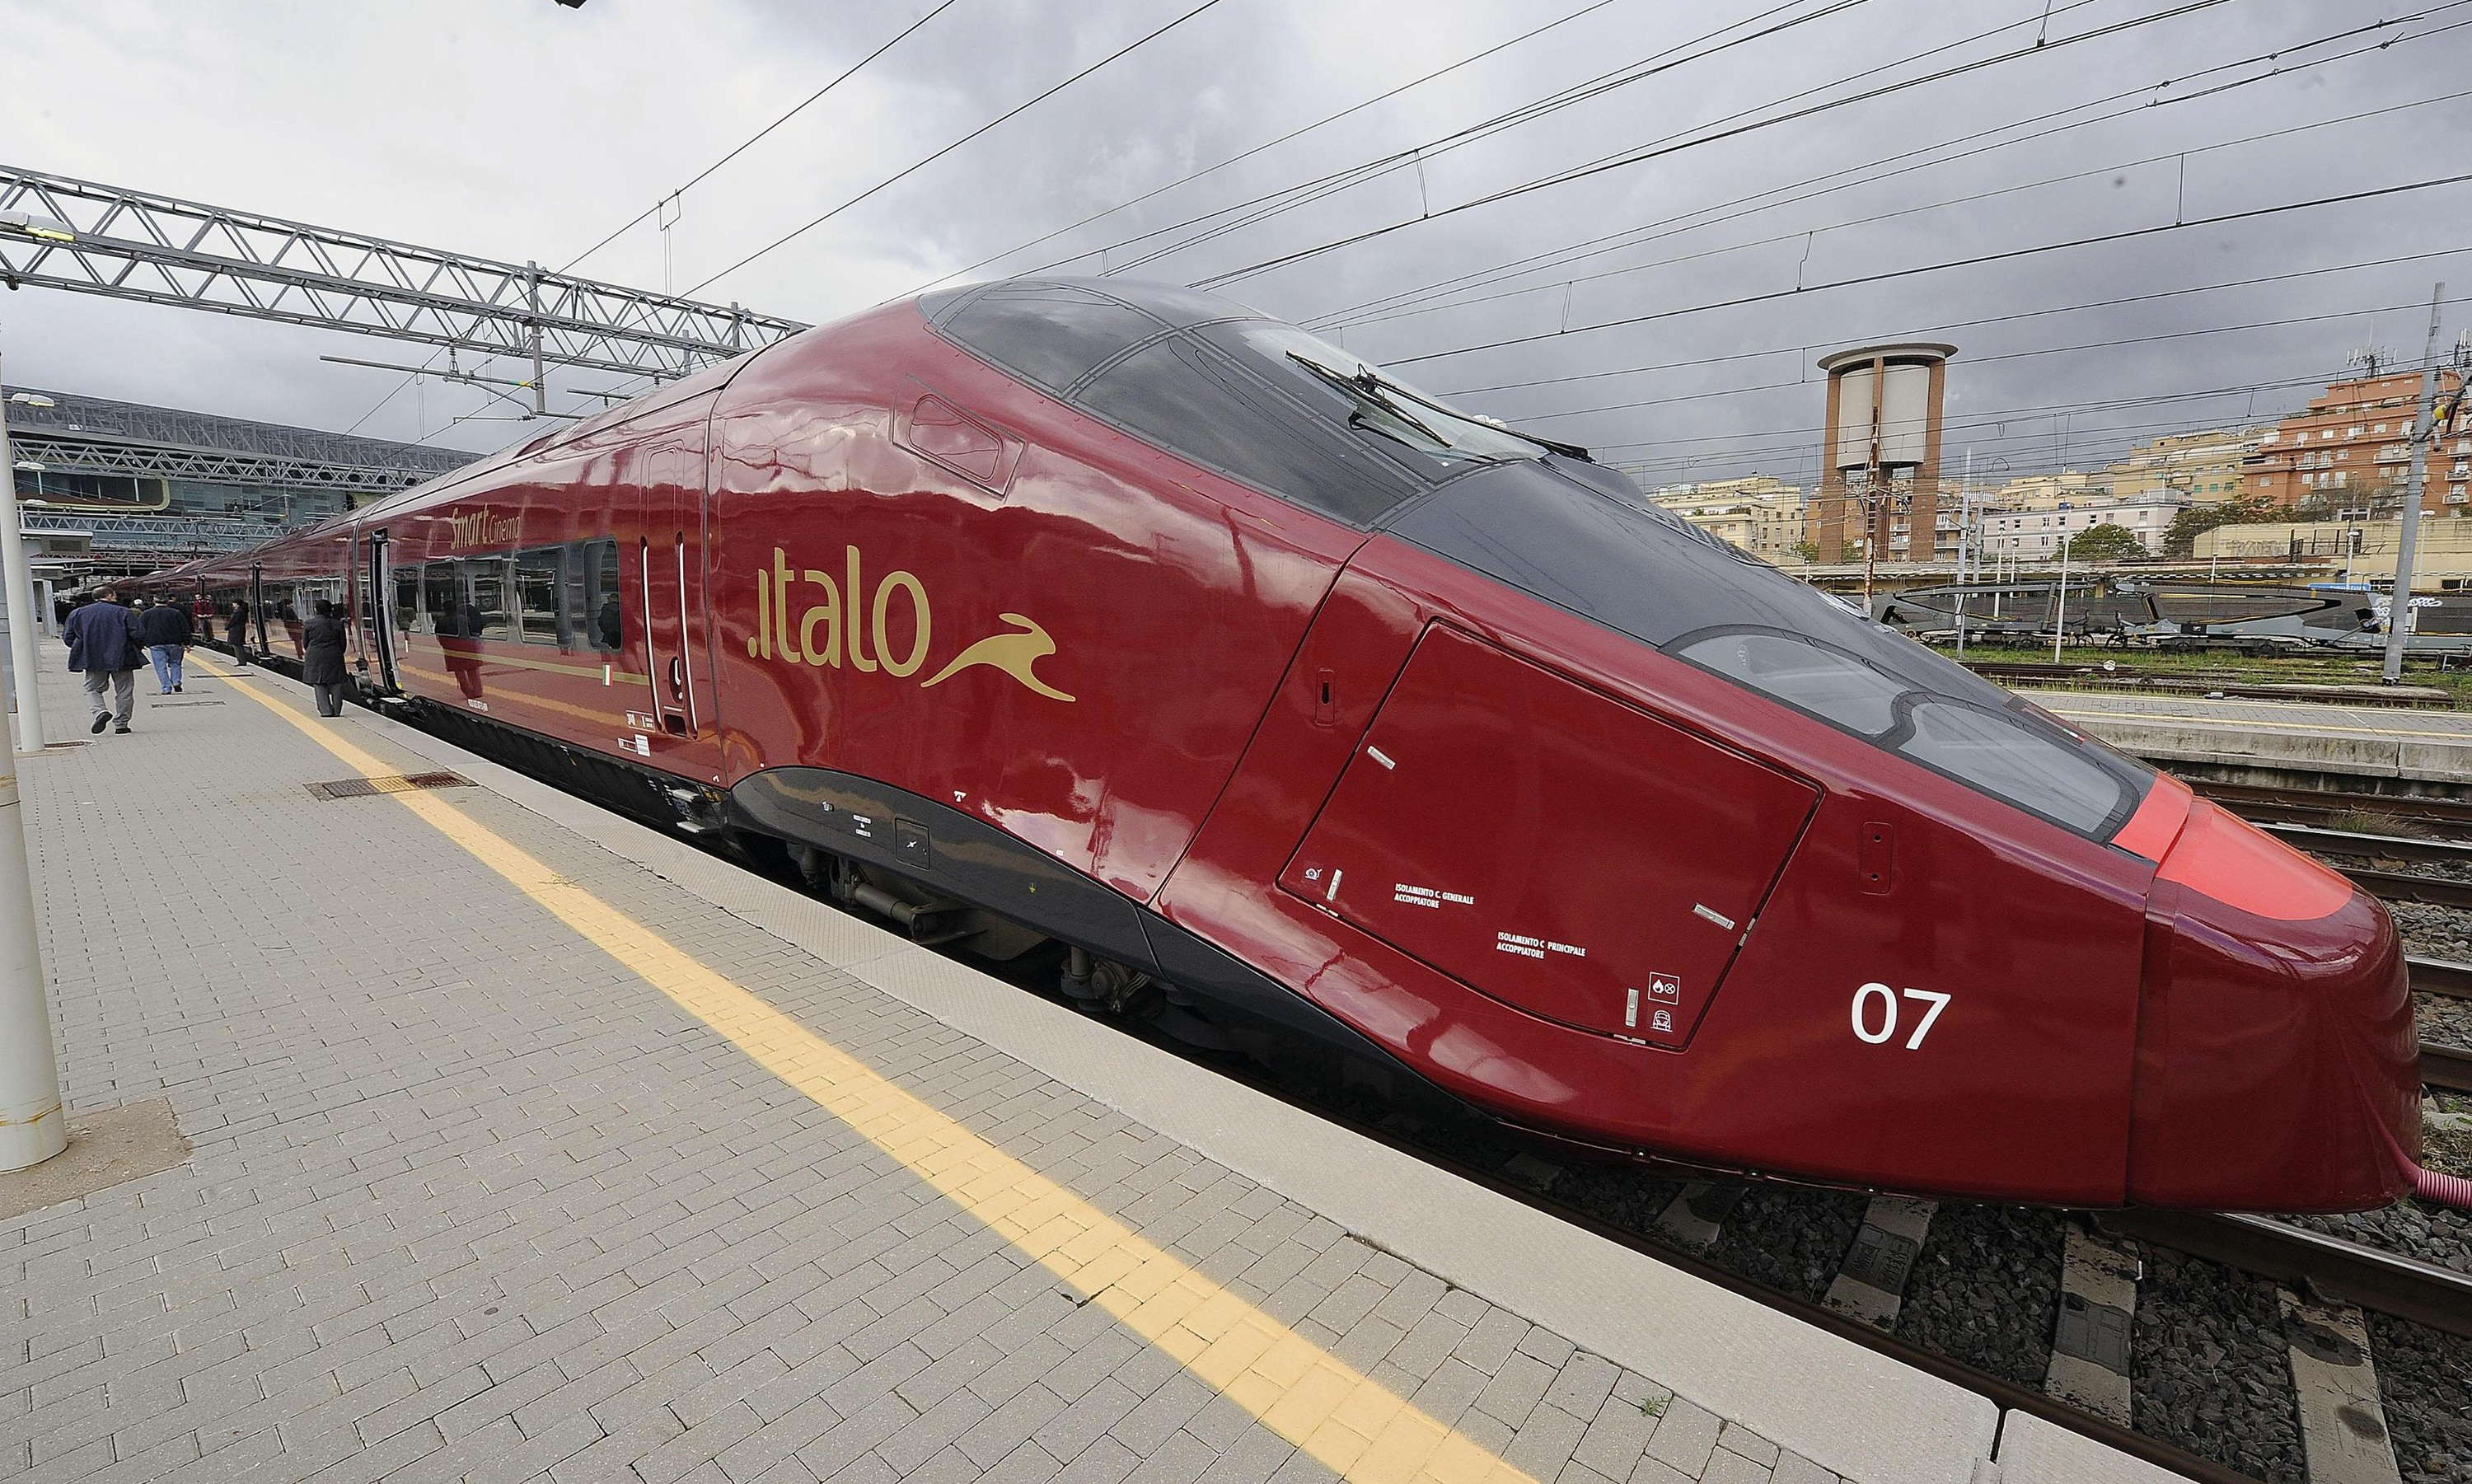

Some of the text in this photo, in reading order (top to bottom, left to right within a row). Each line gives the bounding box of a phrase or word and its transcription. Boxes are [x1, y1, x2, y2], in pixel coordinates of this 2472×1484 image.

[451, 503, 520, 550] Smart Cinema
[1394, 893, 1440, 908] ACCOPPIATORE
[1395, 883, 1434, 897] ISOLAMENTO
[1442, 892, 1474, 905] GENERALE
[1496, 942, 1545, 959] ACCOPPIATORE
[1497, 932, 1538, 947] ISOLAMENTO
[1547, 941, 1586, 957] PRINCIPALE
[1852, 982, 1952, 1051] 07
